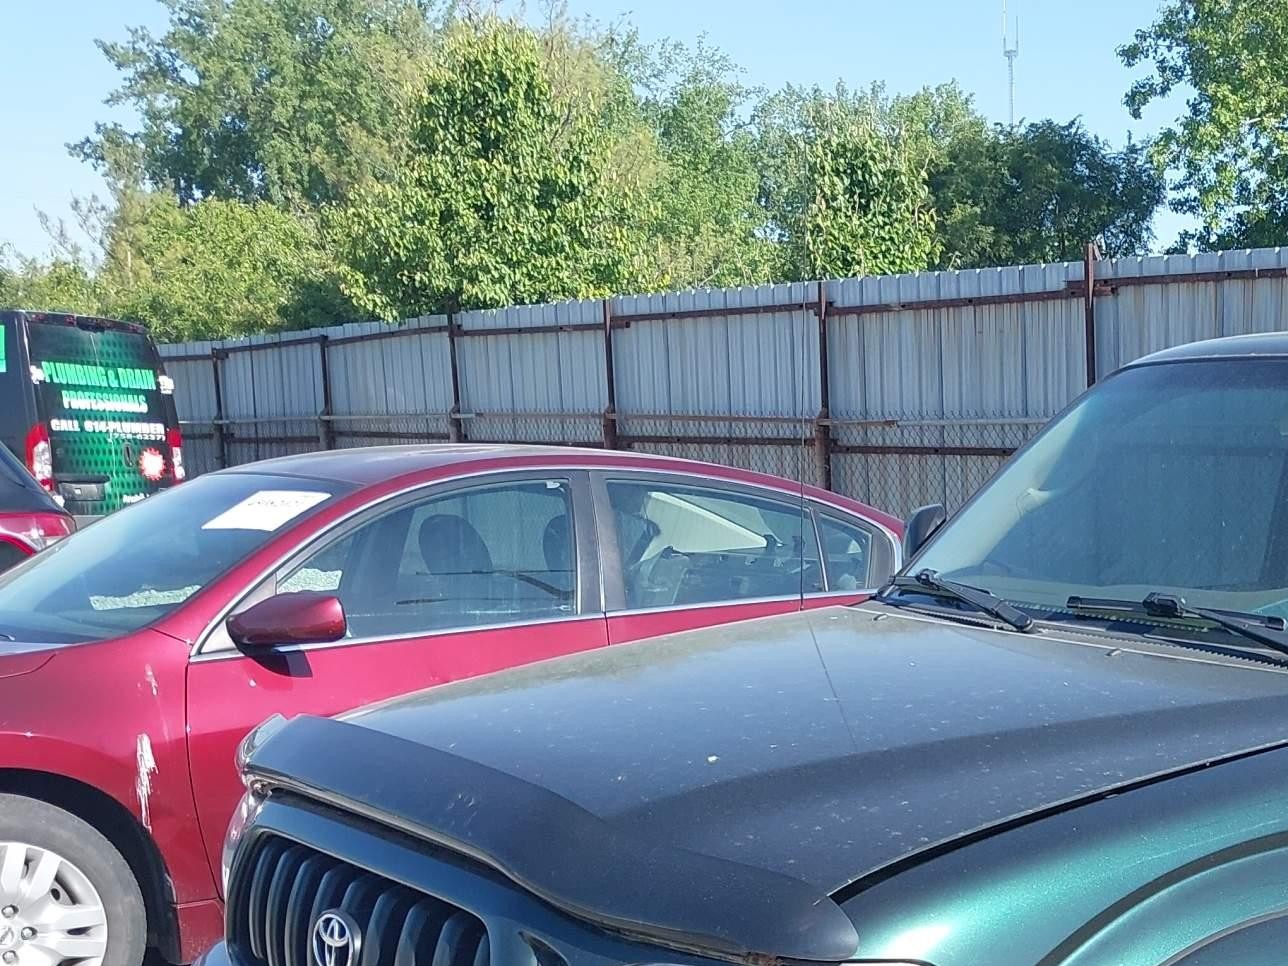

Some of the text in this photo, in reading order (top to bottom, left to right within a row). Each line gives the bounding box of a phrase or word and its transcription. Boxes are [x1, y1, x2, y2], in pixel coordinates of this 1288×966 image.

[41, 361, 156, 390] PLUMBING & DRAIN
[61, 390, 148, 414] PROFESSIONALS
[50, 418, 80, 432] CALL
